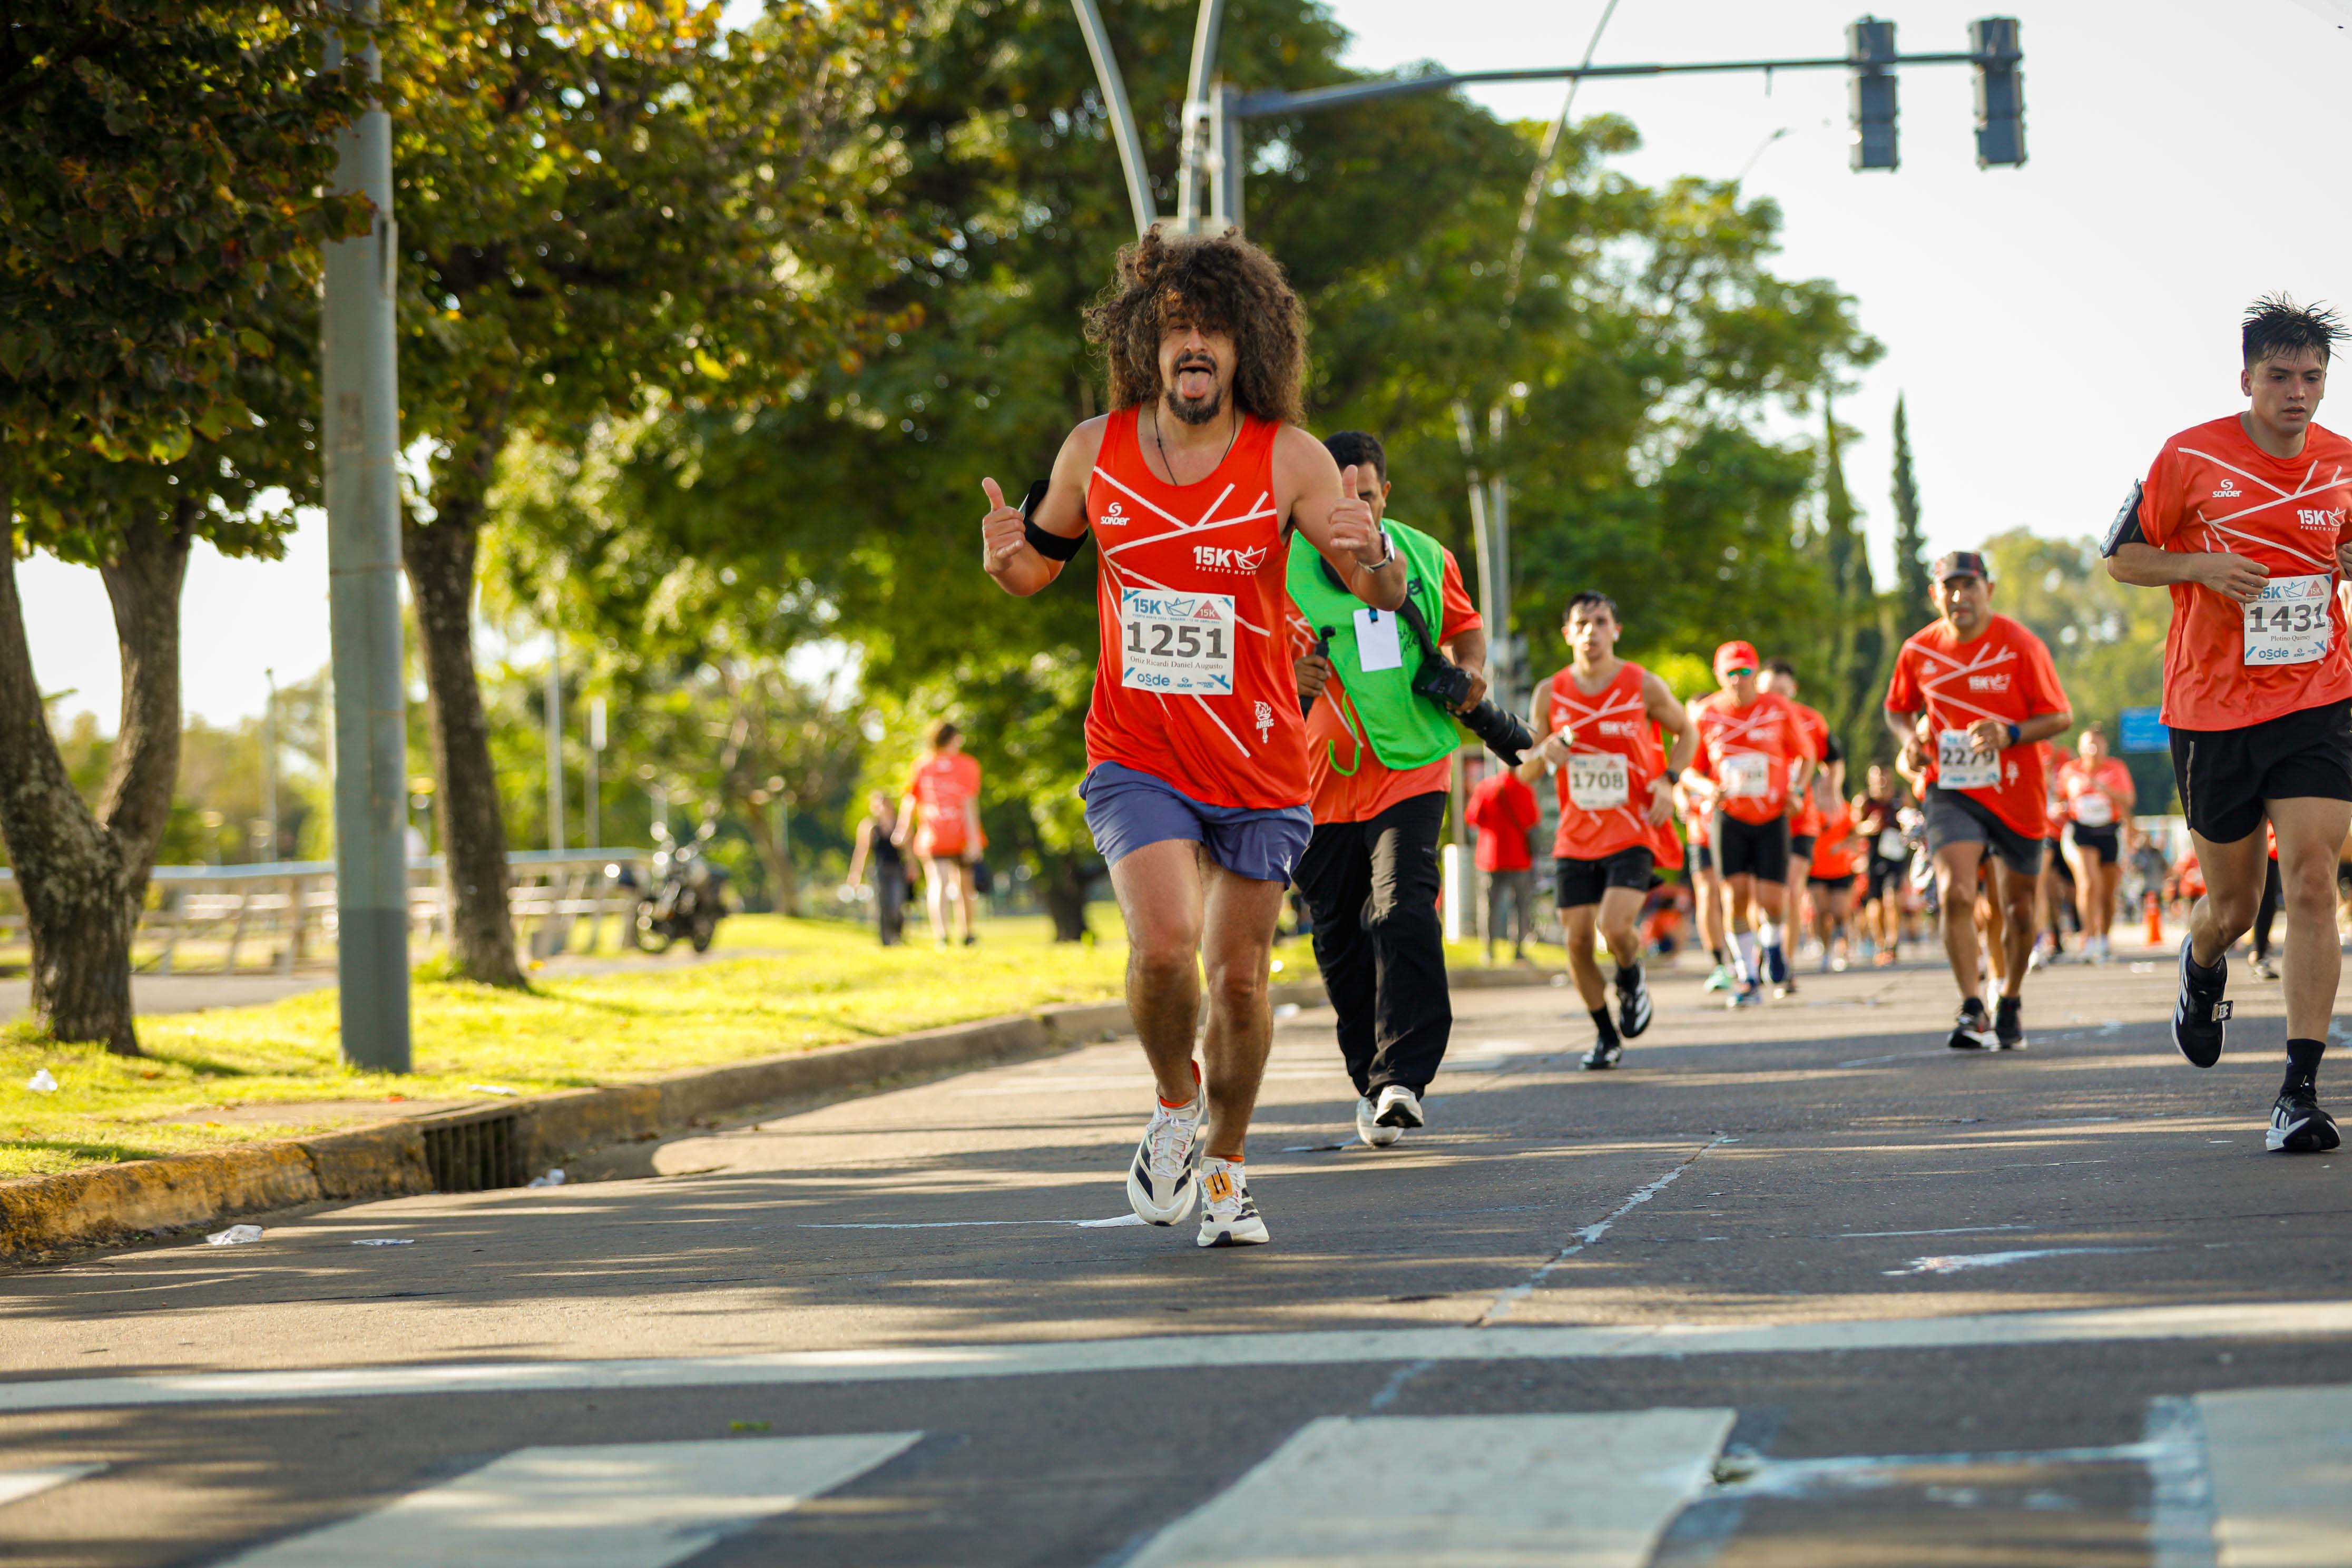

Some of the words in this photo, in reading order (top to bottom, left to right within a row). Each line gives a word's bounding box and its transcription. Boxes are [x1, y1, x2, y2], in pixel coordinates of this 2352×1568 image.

[2297, 509, 2326, 525] 15K
[1193, 546, 1233, 567] 15K
[1195, 565, 1231, 574] PUERTO
[1133, 598, 1162, 615] 15K
[1199, 608, 1215, 618] 15K
[2250, 603, 2326, 632] 1431
[1127, 621, 1227, 659] 1251
[1130, 655, 1145, 664] Ortiz
[1146, 658, 1169, 667] Ricardi
[1195, 662, 1223, 670] Augusto
[1256, 718, 1274, 730] ARDEC
[1573, 771, 1624, 790] 1708
